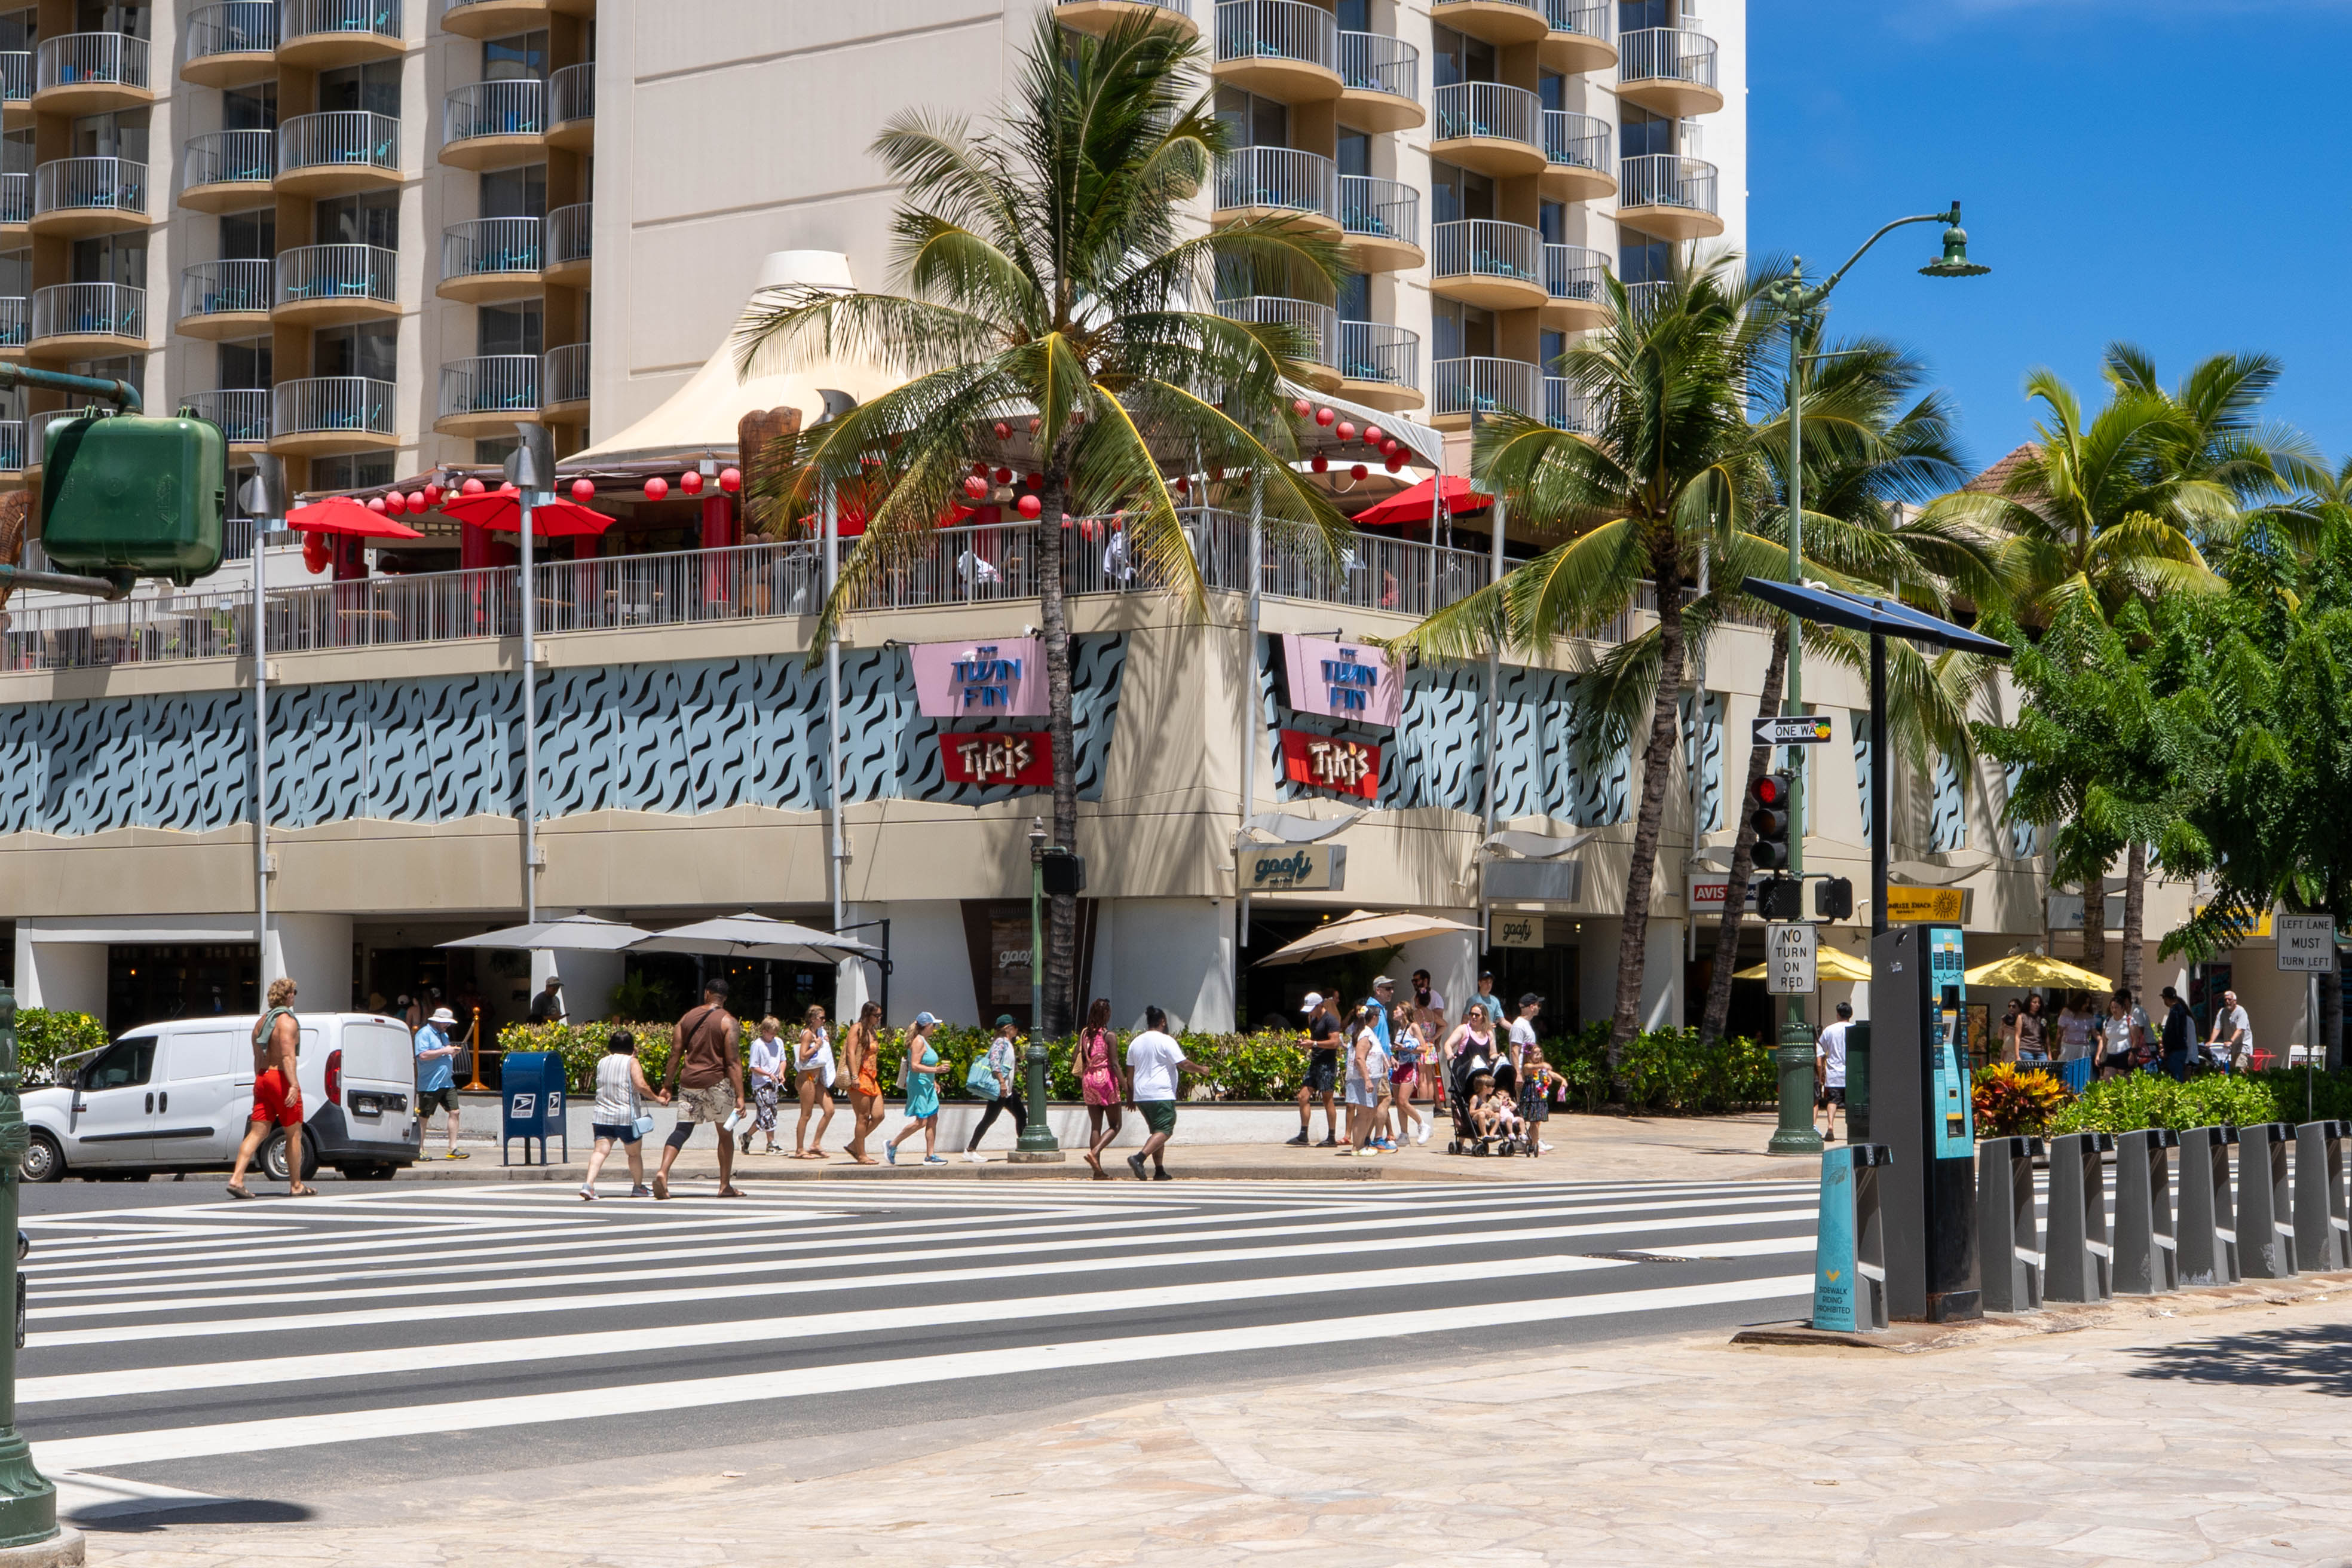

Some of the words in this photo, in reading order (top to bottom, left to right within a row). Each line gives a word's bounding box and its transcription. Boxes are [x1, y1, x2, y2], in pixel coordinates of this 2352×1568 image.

[951, 659, 1021, 682] TWIN
[1321, 660, 1377, 686] TWIN
[964, 685, 1008, 708] FIN
[1330, 687, 1366, 710] FIN
[1775, 726, 1797, 736] ONE
[1800, 725, 1817, 736] WA
[1254, 850, 1313, 882] goofy
[1696, 887, 1725, 899] AVIS
[1503, 918, 1532, 941] goofy
[2282, 920, 2303, 929] LEFT
[2307, 920, 2330, 930] LANE
[1783, 929, 1802, 943] NO
[2292, 937, 2320, 949] MUST
[999, 947, 1033, 968] goof
[1776, 947, 1807, 958] TURN
[1784, 962, 1799, 973] ON
[2281, 957, 2304, 966] TURN
[2308, 957, 2329, 966] LEFT
[1781, 977, 1803, 987] RED
[1819, 1286, 1848, 1295] SIDEWALK
[1823, 1296, 1843, 1304] RIDING
[1817, 1305, 1851, 1314] PROHIBITED
